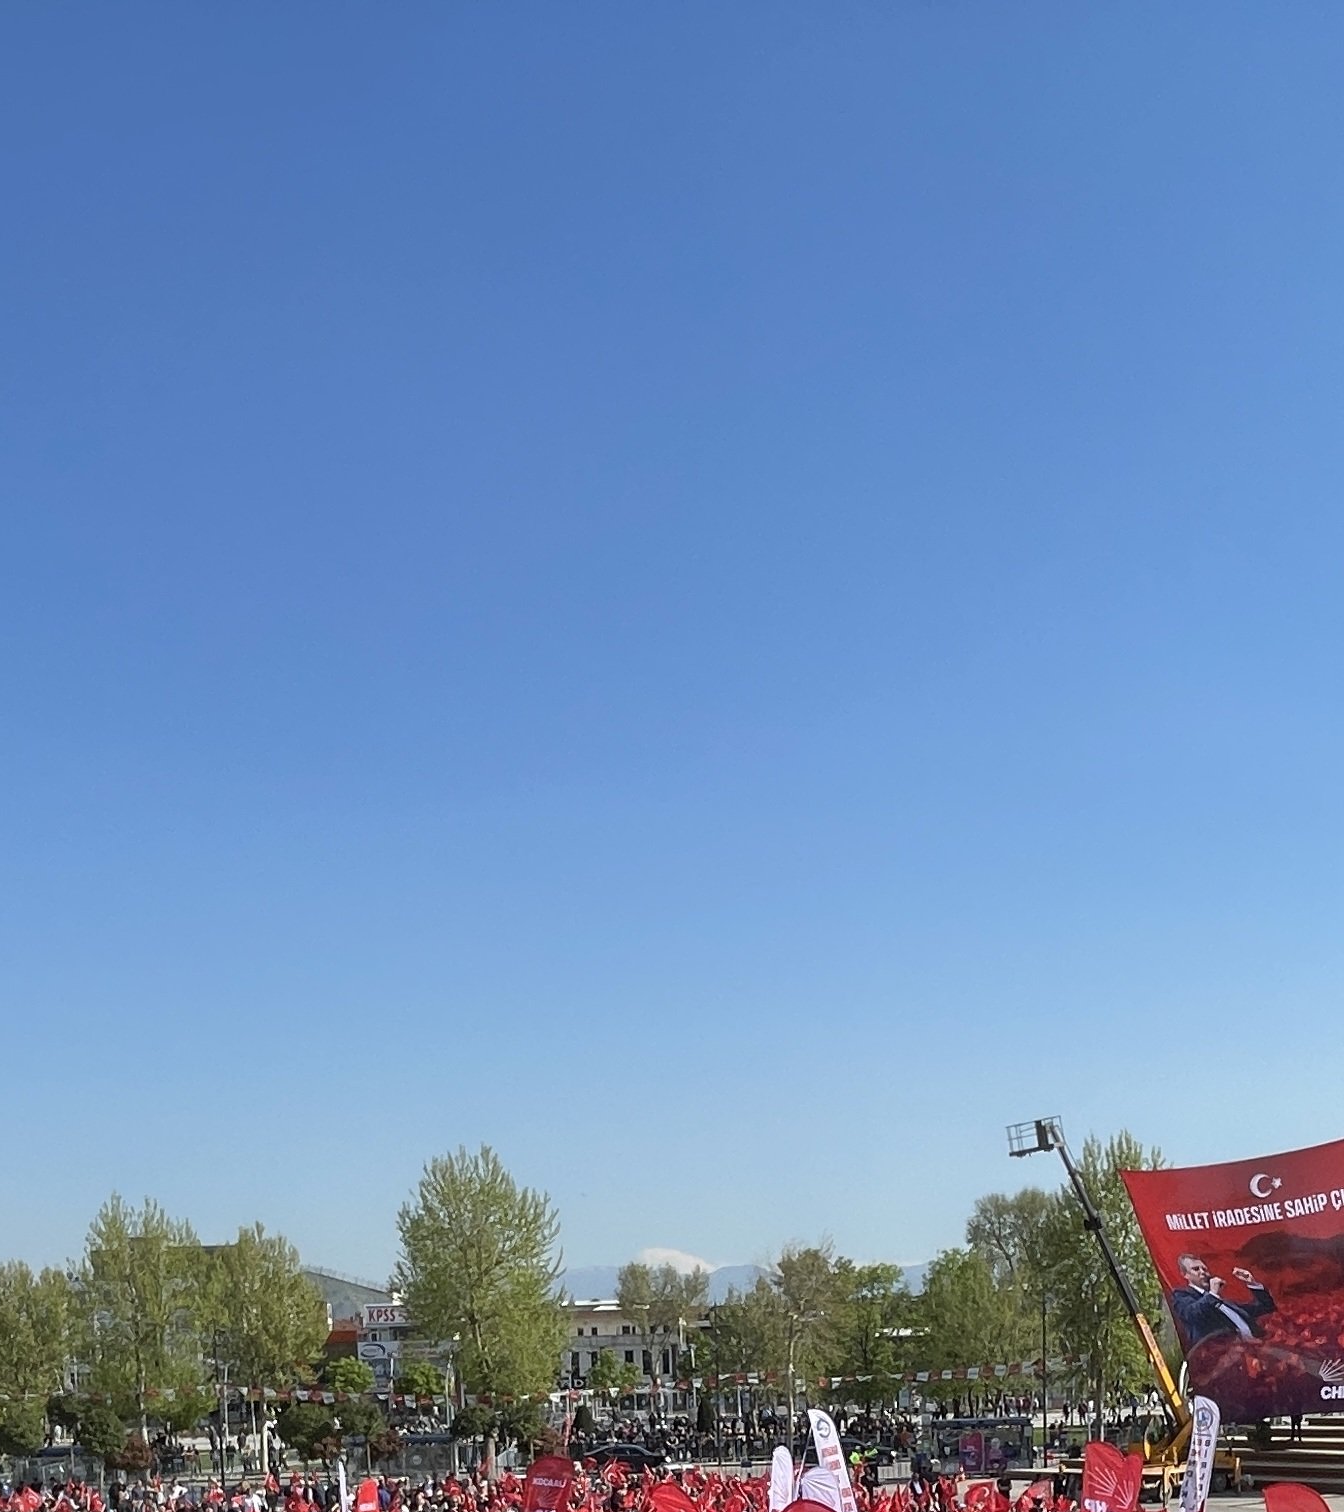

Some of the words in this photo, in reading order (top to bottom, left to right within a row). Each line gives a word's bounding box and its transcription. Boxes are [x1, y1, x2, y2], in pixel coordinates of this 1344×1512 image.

[1166, 1211, 1209, 1230] MİLLET
[1212, 1202, 1283, 1228] İRADESİNE
[1284, 1193, 1328, 1218] SAHİP
[368, 1309, 396, 1322] KPSS
